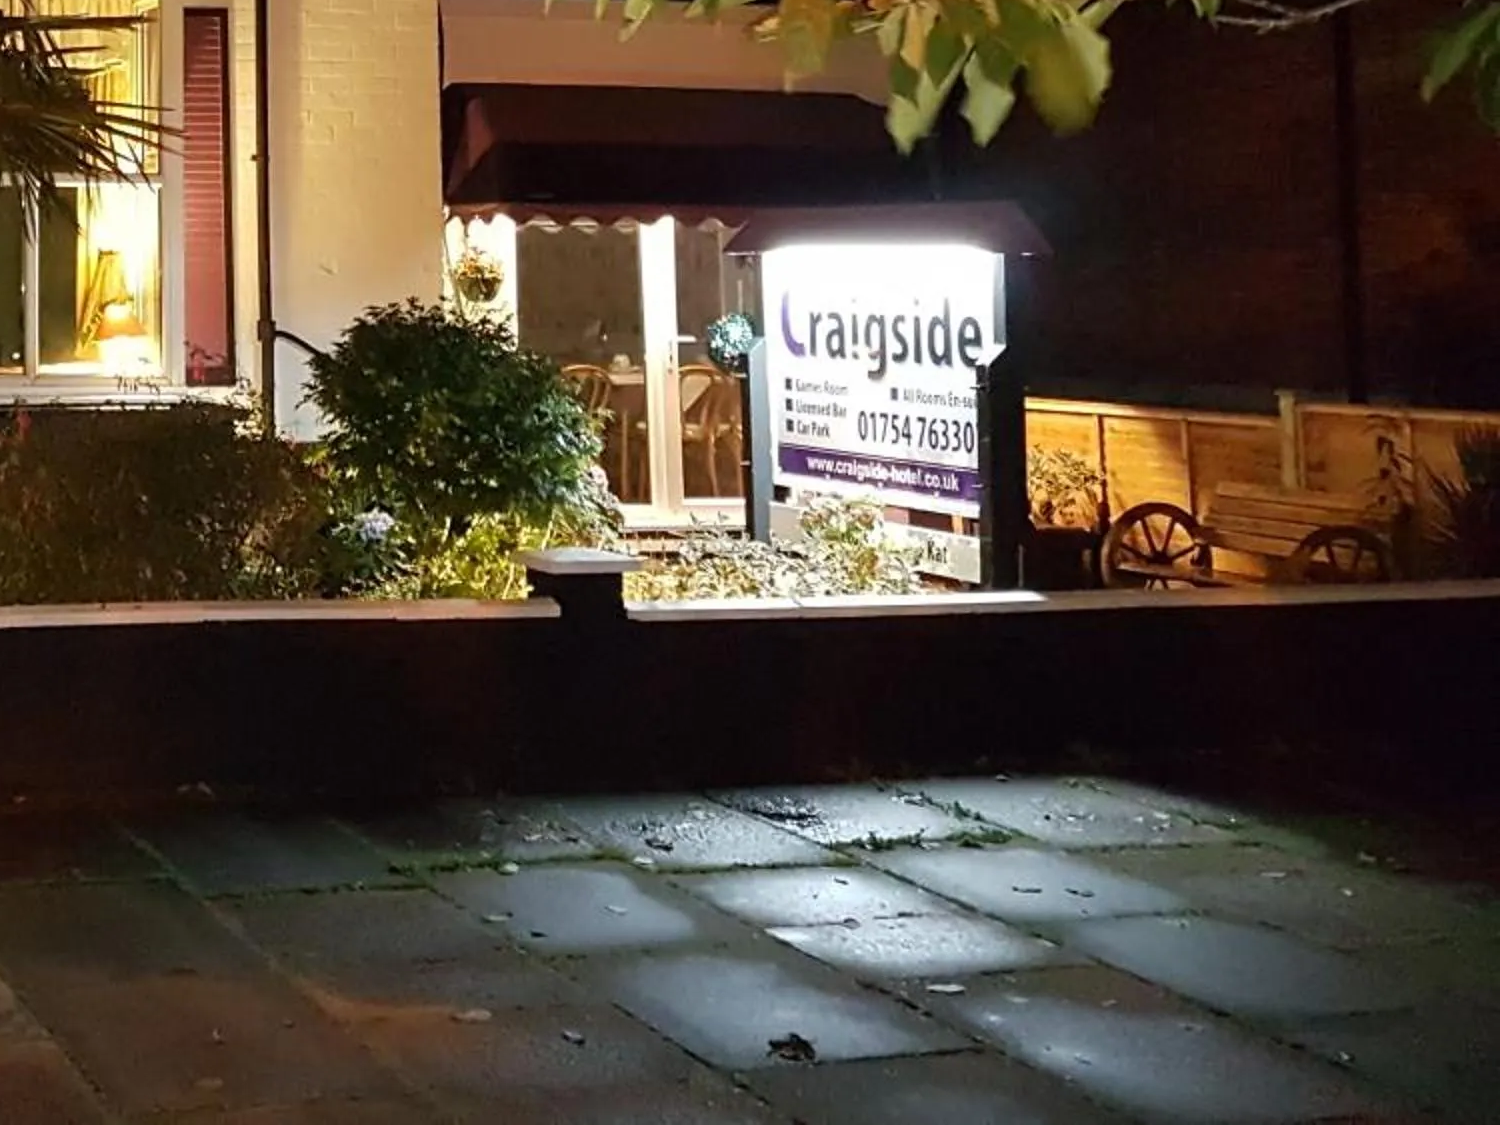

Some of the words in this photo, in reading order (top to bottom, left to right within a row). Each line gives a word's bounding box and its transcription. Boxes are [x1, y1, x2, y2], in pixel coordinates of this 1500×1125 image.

[781, 289, 985, 383] Craigside
[795, 398, 831, 417] Licensed
[832, 402, 847, 418] Bar
[916, 388, 947, 406] Rooms
[797, 419, 810, 435] Car
[811, 421, 831, 439] Park
[916, 416, 975, 454] 76330
[806, 455, 960, 492] www.craigside-hotel.co.uk
